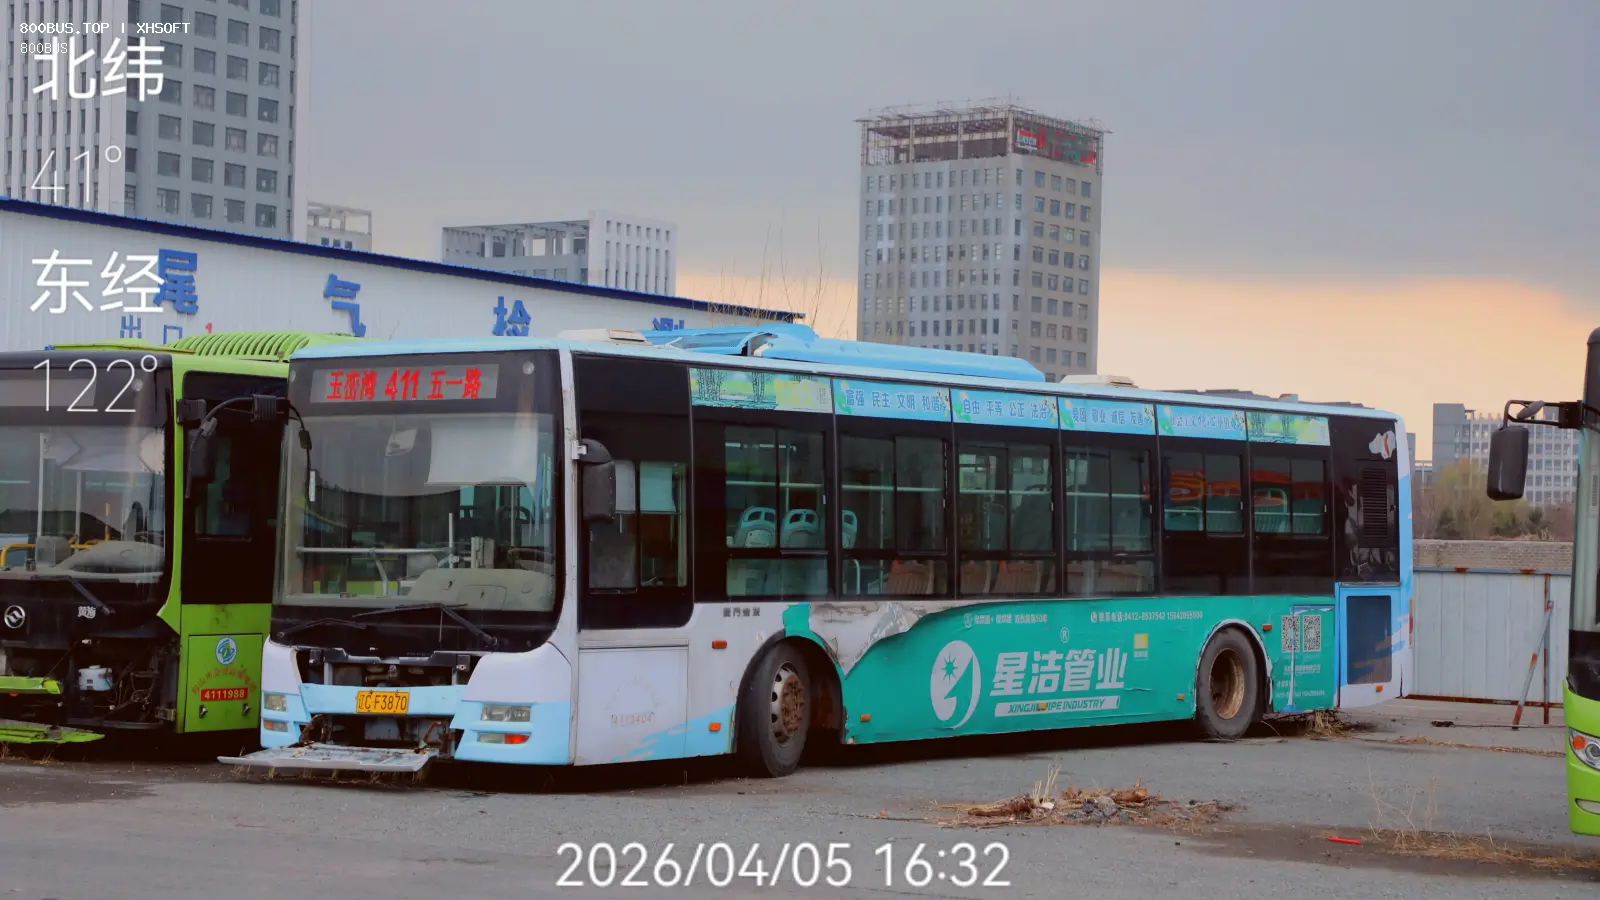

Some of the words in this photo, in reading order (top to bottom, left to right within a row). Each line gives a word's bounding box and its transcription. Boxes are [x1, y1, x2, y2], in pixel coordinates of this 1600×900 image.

[384, 368, 420, 400] 411
[427, 368, 481, 399] 五一路
[845, 389, 865, 407] 富强
[872, 391, 891, 408] 民主
[897, 393, 915, 410] 文明
[921, 395, 941, 412] 和谐
[963, 399, 980, 415] 自由
[986, 400, 1003, 416] 平等
[1008, 402, 1025, 418] 公正
[1031, 403, 1048, 419] 法治
[989, 647, 1128, 697] 星洁管业
[204, 689, 245, 700] 4111988
[1008, 703, 1042, 714] XINGJI
[1063, 698, 1105, 710] INDUSTRY
